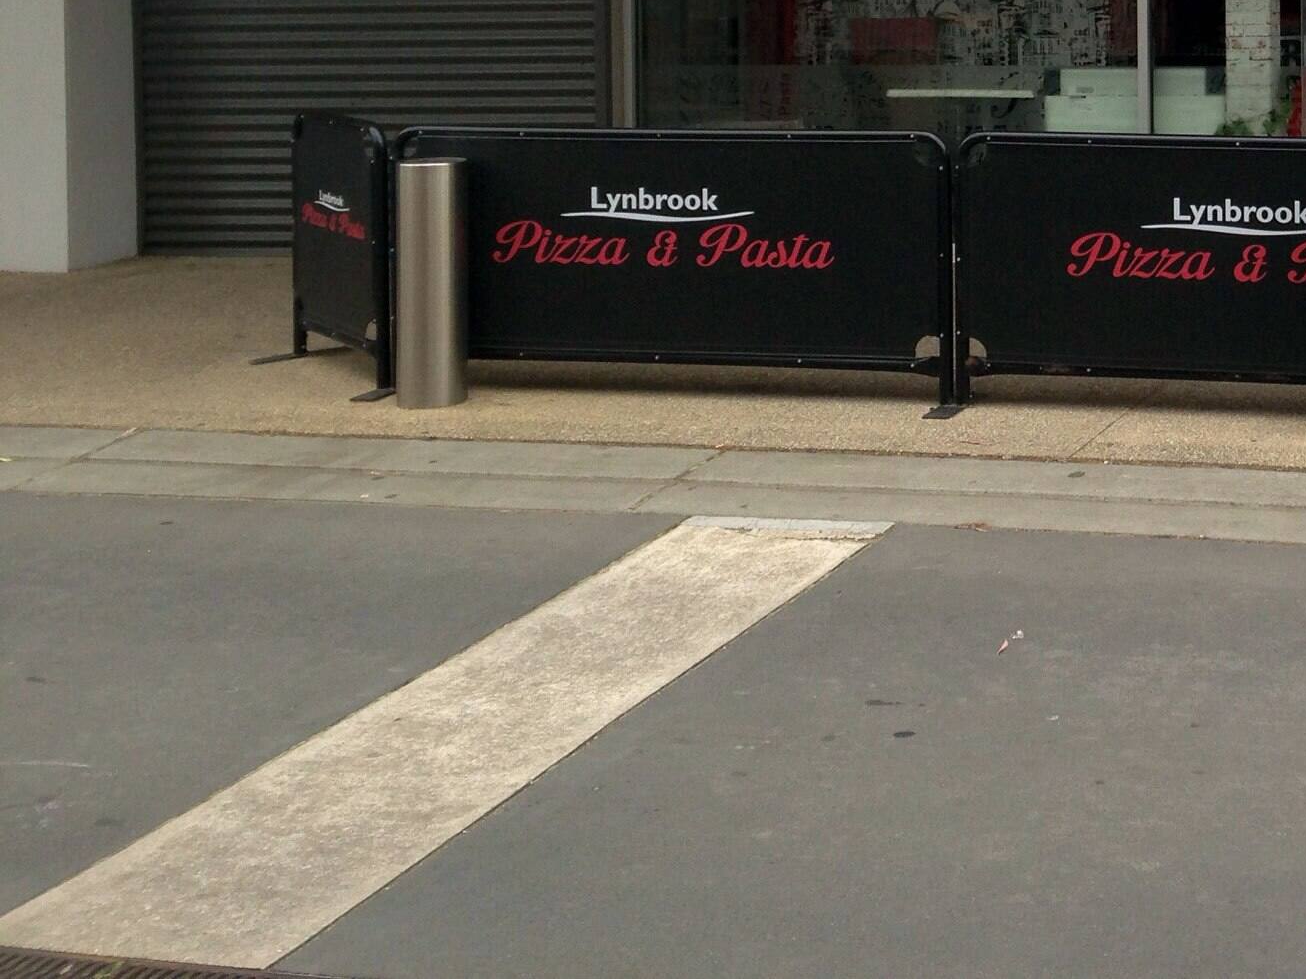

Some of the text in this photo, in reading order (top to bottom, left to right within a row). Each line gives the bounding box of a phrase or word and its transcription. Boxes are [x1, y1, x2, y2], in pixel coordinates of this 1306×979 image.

[590, 186, 719, 213] Lynbrook
[491, 220, 836, 270] Pizza & Pasta
[1064, 231, 1216, 279] Pizza
[1231, 243, 1268, 284] &
